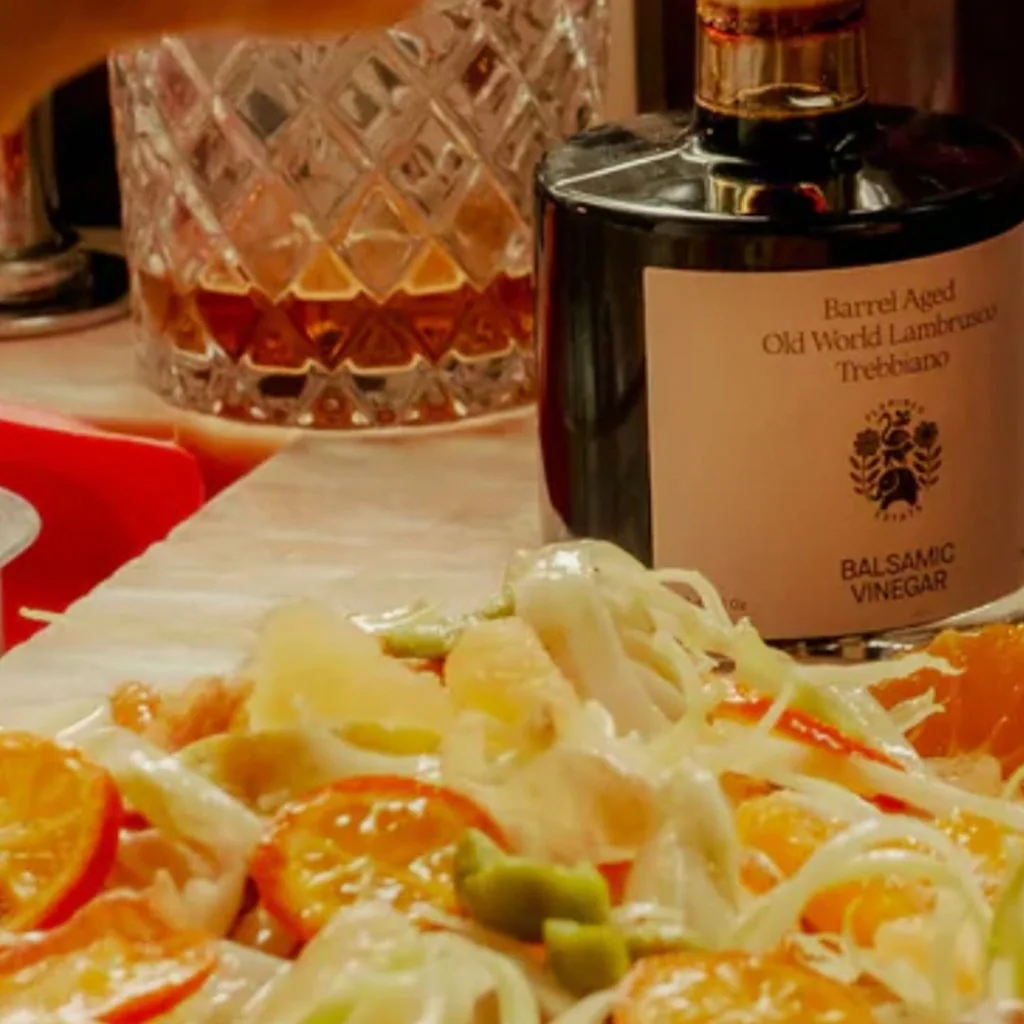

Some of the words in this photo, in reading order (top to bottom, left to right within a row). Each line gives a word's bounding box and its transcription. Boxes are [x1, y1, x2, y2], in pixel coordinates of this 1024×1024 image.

[823, 291, 898, 322] Barrel
[903, 279, 957, 313] Aged
[762, 332, 805, 356] Old
[811, 326, 884, 353] World
[888, 305, 998, 346] Lambrusco
[835, 348, 951, 383] Trebbiano
[841, 542, 956, 581] BALSAMIC
[850, 569, 949, 605] VINEGAR
